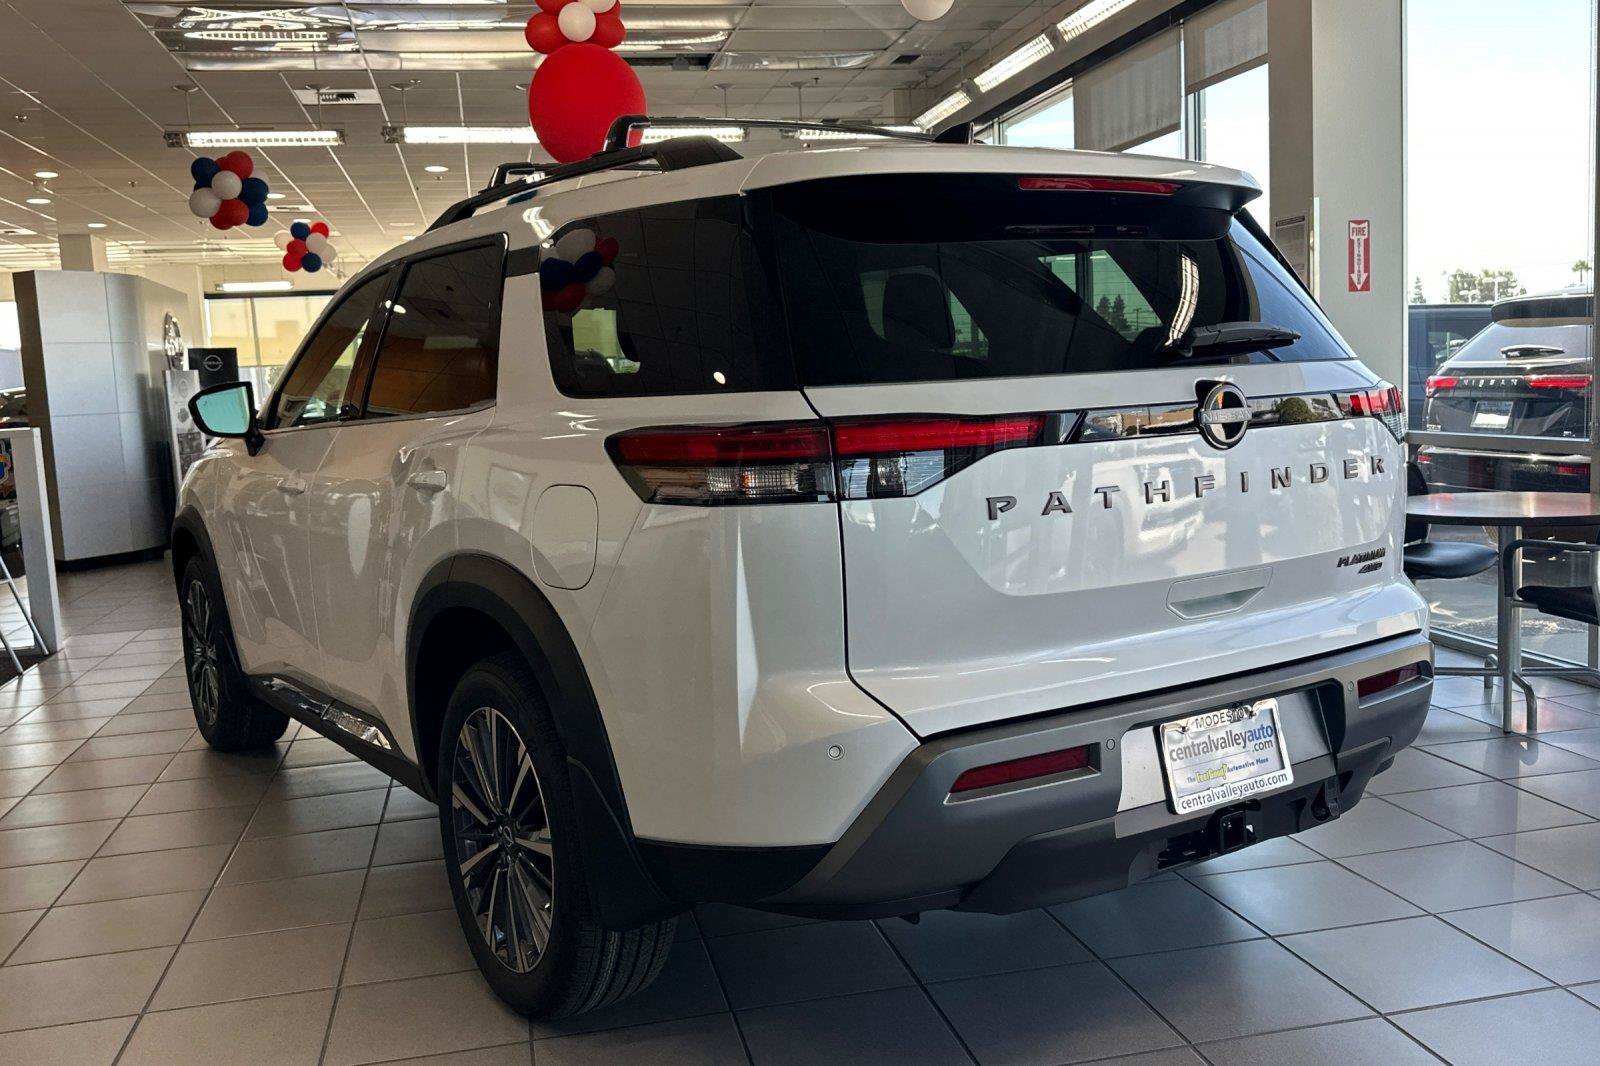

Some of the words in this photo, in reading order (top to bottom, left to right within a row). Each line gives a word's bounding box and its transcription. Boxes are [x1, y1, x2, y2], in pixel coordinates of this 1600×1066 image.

[1351, 227, 1367, 236] FIRE
[1463, 379, 1518, 388] NISSAN
[986, 455, 1386, 521] PATHFINDER
[1170, 724, 1274, 762] centralvalleyauto
[1252, 739, 1274, 753] .com
[1181, 772, 1288, 810] centralvalleyauto.com
